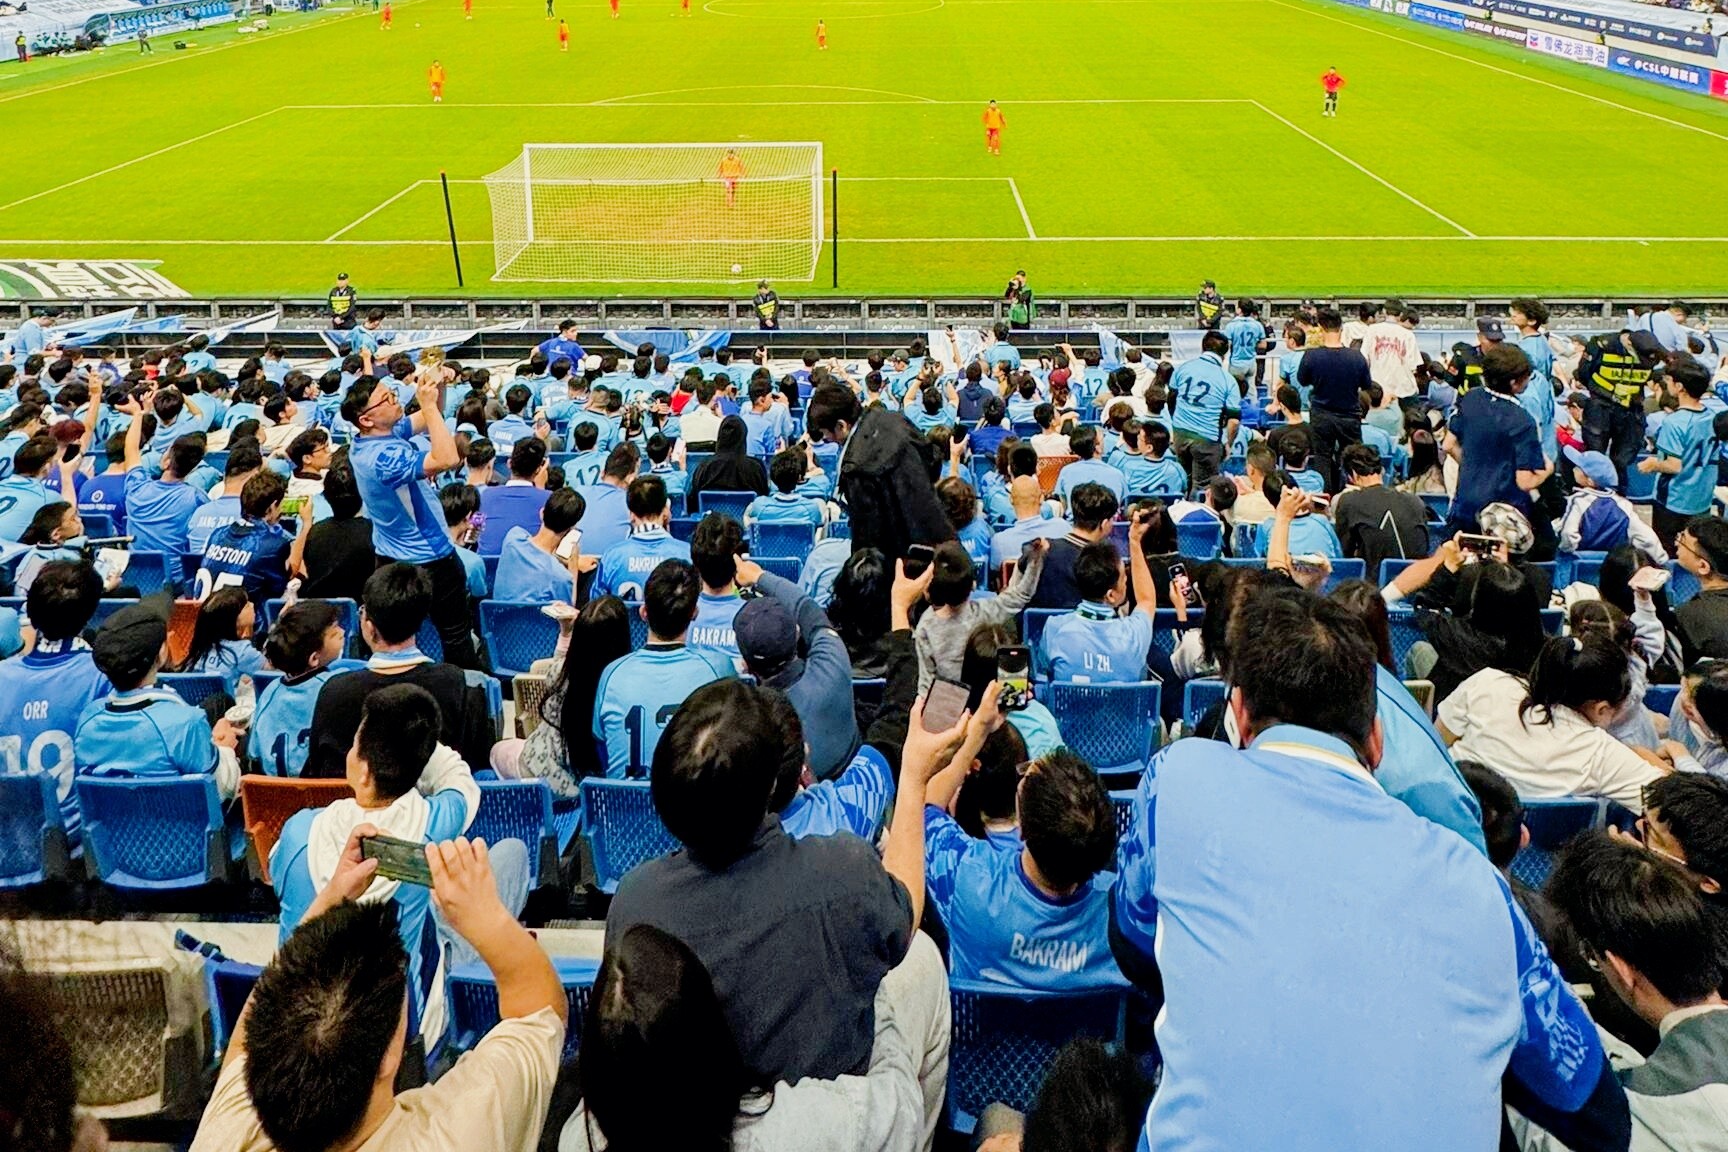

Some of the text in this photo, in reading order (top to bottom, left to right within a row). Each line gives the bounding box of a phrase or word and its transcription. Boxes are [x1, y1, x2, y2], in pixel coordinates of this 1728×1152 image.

[1239, 331, 1255, 349] 12
[1084, 378, 1104, 396] 12
[1182, 375, 1211, 407] 12
[576, 464, 601, 486] 12
[206, 544, 252, 566] BASTONI
[692, 627, 736, 647] BAKRAM
[1083, 651, 1094, 670] LI
[23, 700, 48, 720] ORR
[0, 729, 76, 803] 19
[1010, 932, 1088, 973] BAKRAM
